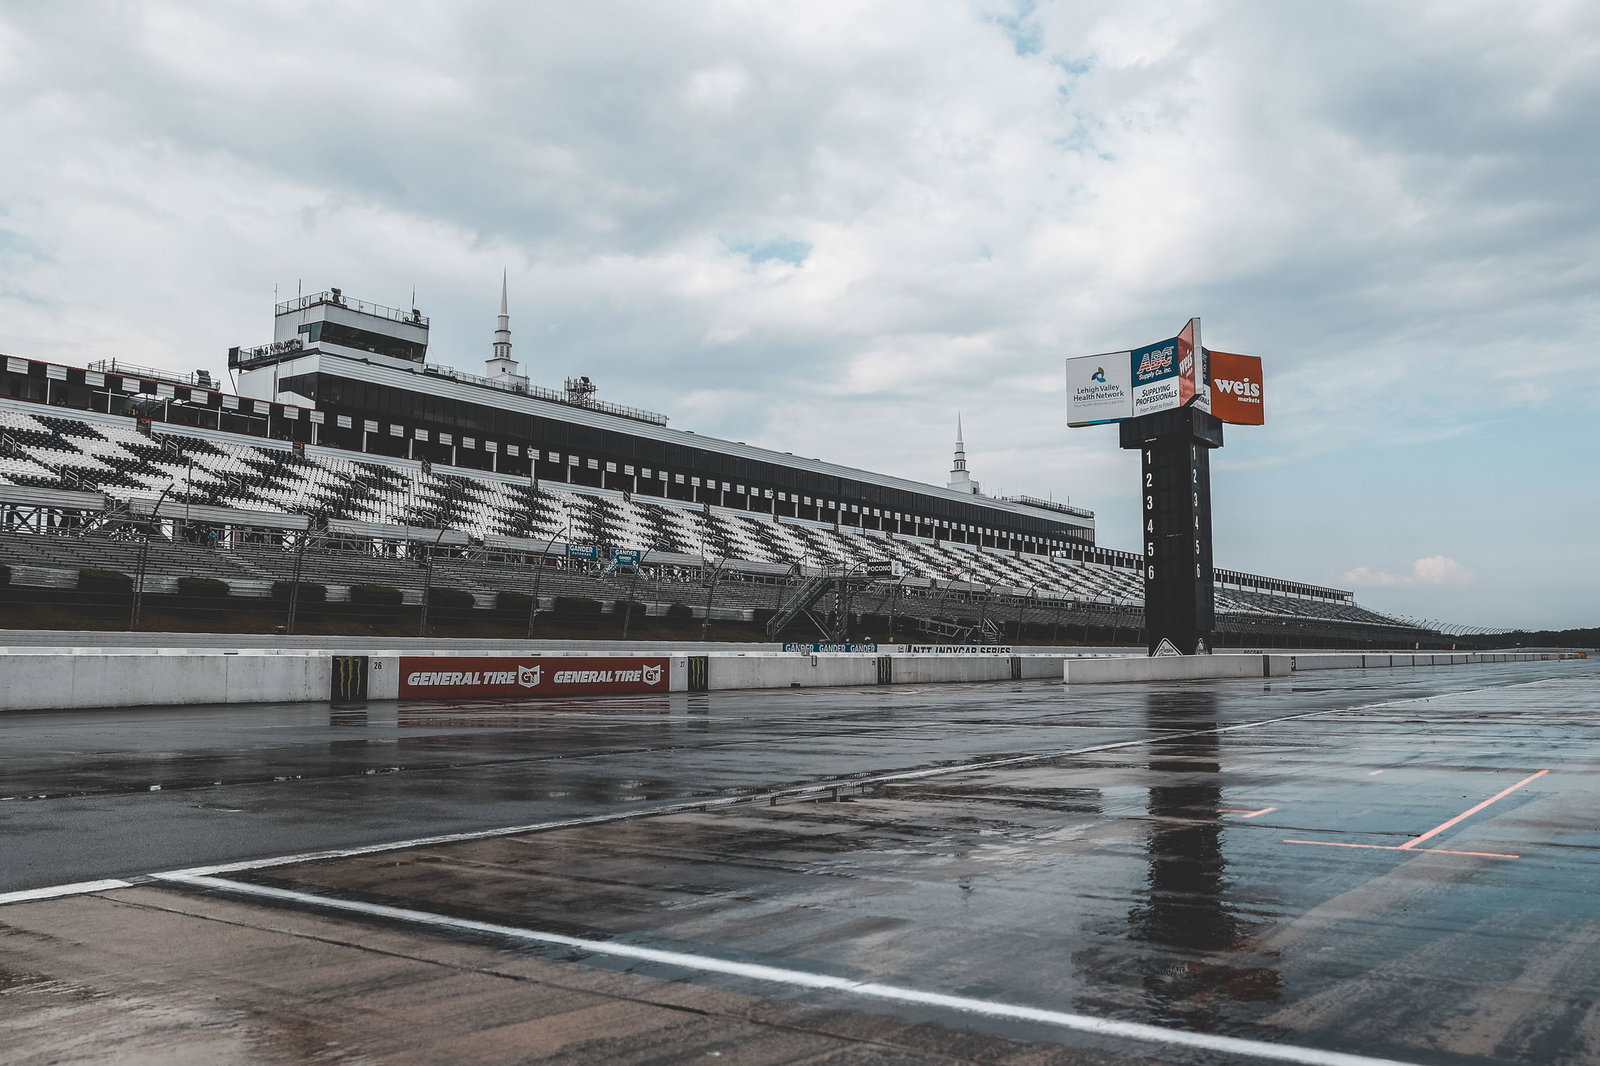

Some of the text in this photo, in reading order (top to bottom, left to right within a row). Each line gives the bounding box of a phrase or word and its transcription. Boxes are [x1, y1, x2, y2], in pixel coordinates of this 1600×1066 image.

[1136, 346, 1173, 375] ABC
[1138, 371, 1154, 380] Supply
[1076, 384, 1120, 395] Lehigh Valley
[1213, 377, 1260, 397] weis
[1073, 390, 1125, 402] Health Network
[1135, 389, 1178, 407] PROFESSIONALS
[1146, 449, 1151, 464] 1
[1192, 445, 1196, 460] 1
[1146, 472, 1153, 488] 2
[1192, 468, 1197, 483] 2
[1146, 495, 1153, 510] 3
[1193, 492, 1198, 507] 3
[1147, 518, 1154, 533] 4
[1194, 515, 1199, 530] 4
[1148, 542, 1154, 556] 5
[1195, 539, 1200, 554] 5
[1148, 565, 1154, 580] 6
[1196, 563, 1200, 578] 6
[819, 644, 846, 653] GANDER
[850, 644, 876, 653] GANDER
[373, 662, 382, 670] 26
[407, 672, 481, 686] GENERAL
[483, 671, 517, 685] TIRE
[554, 670, 614, 684] GENERAL
[614, 670, 642, 682] TIRE
